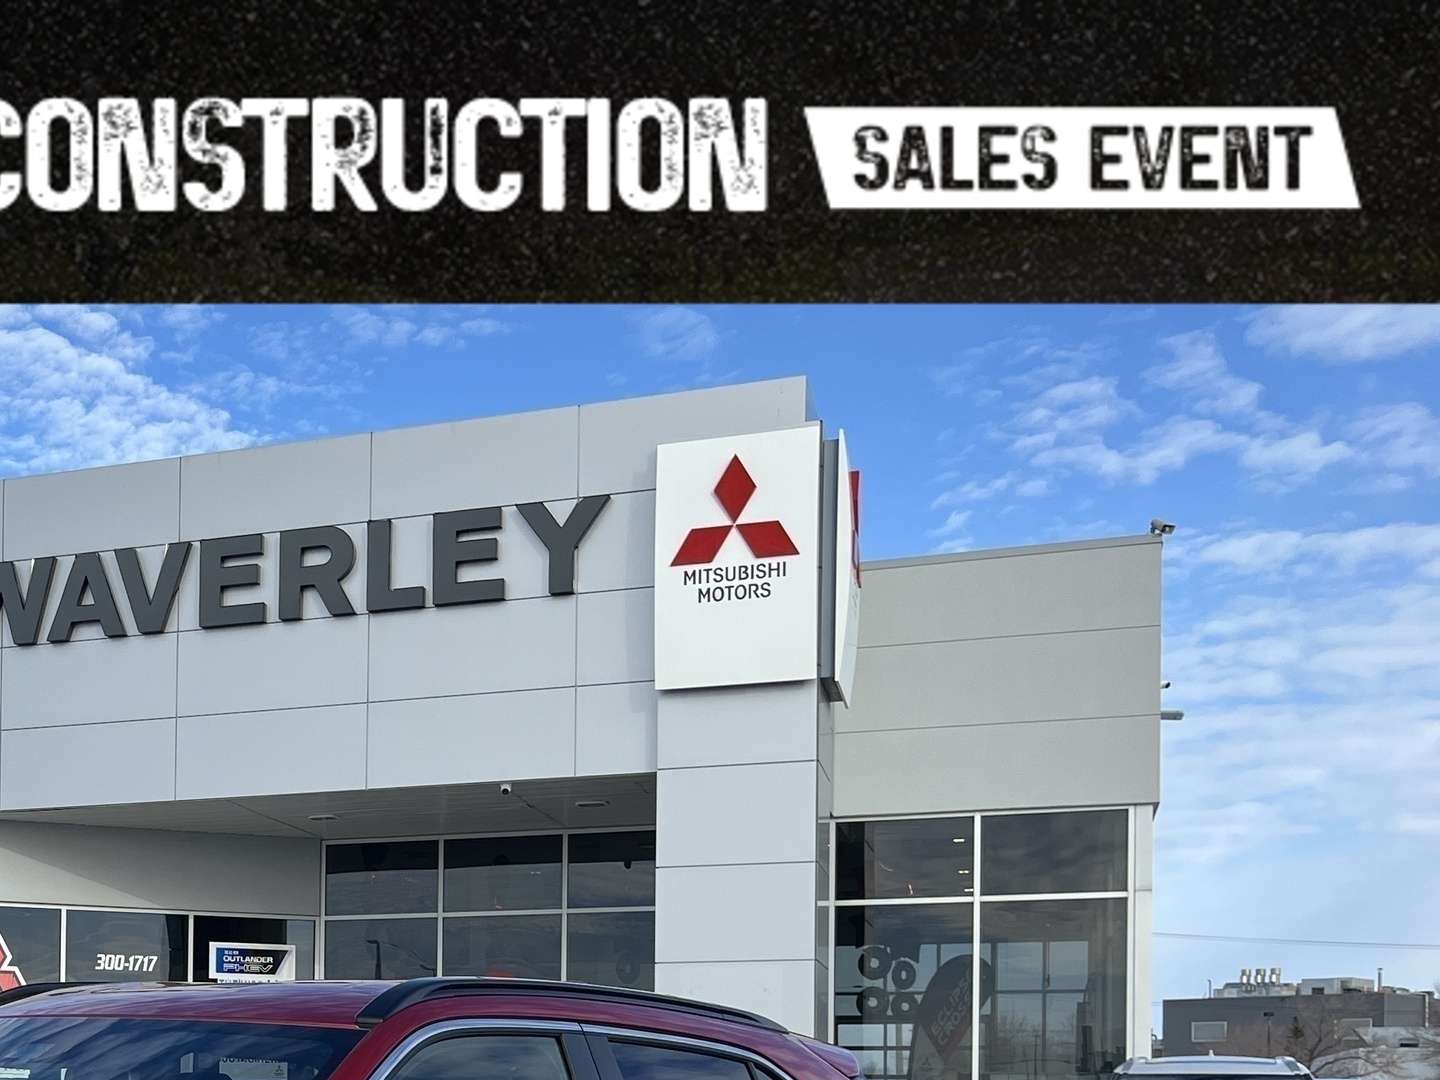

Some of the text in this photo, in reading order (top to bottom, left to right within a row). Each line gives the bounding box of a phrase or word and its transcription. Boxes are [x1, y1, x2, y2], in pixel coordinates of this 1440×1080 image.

[683, 561, 787, 586] MITSUBISHI
[697, 582, 772, 603] MOTORS
[95, 953, 158, 972] 300-1717
[223, 956, 274, 964] OUTLANDER
